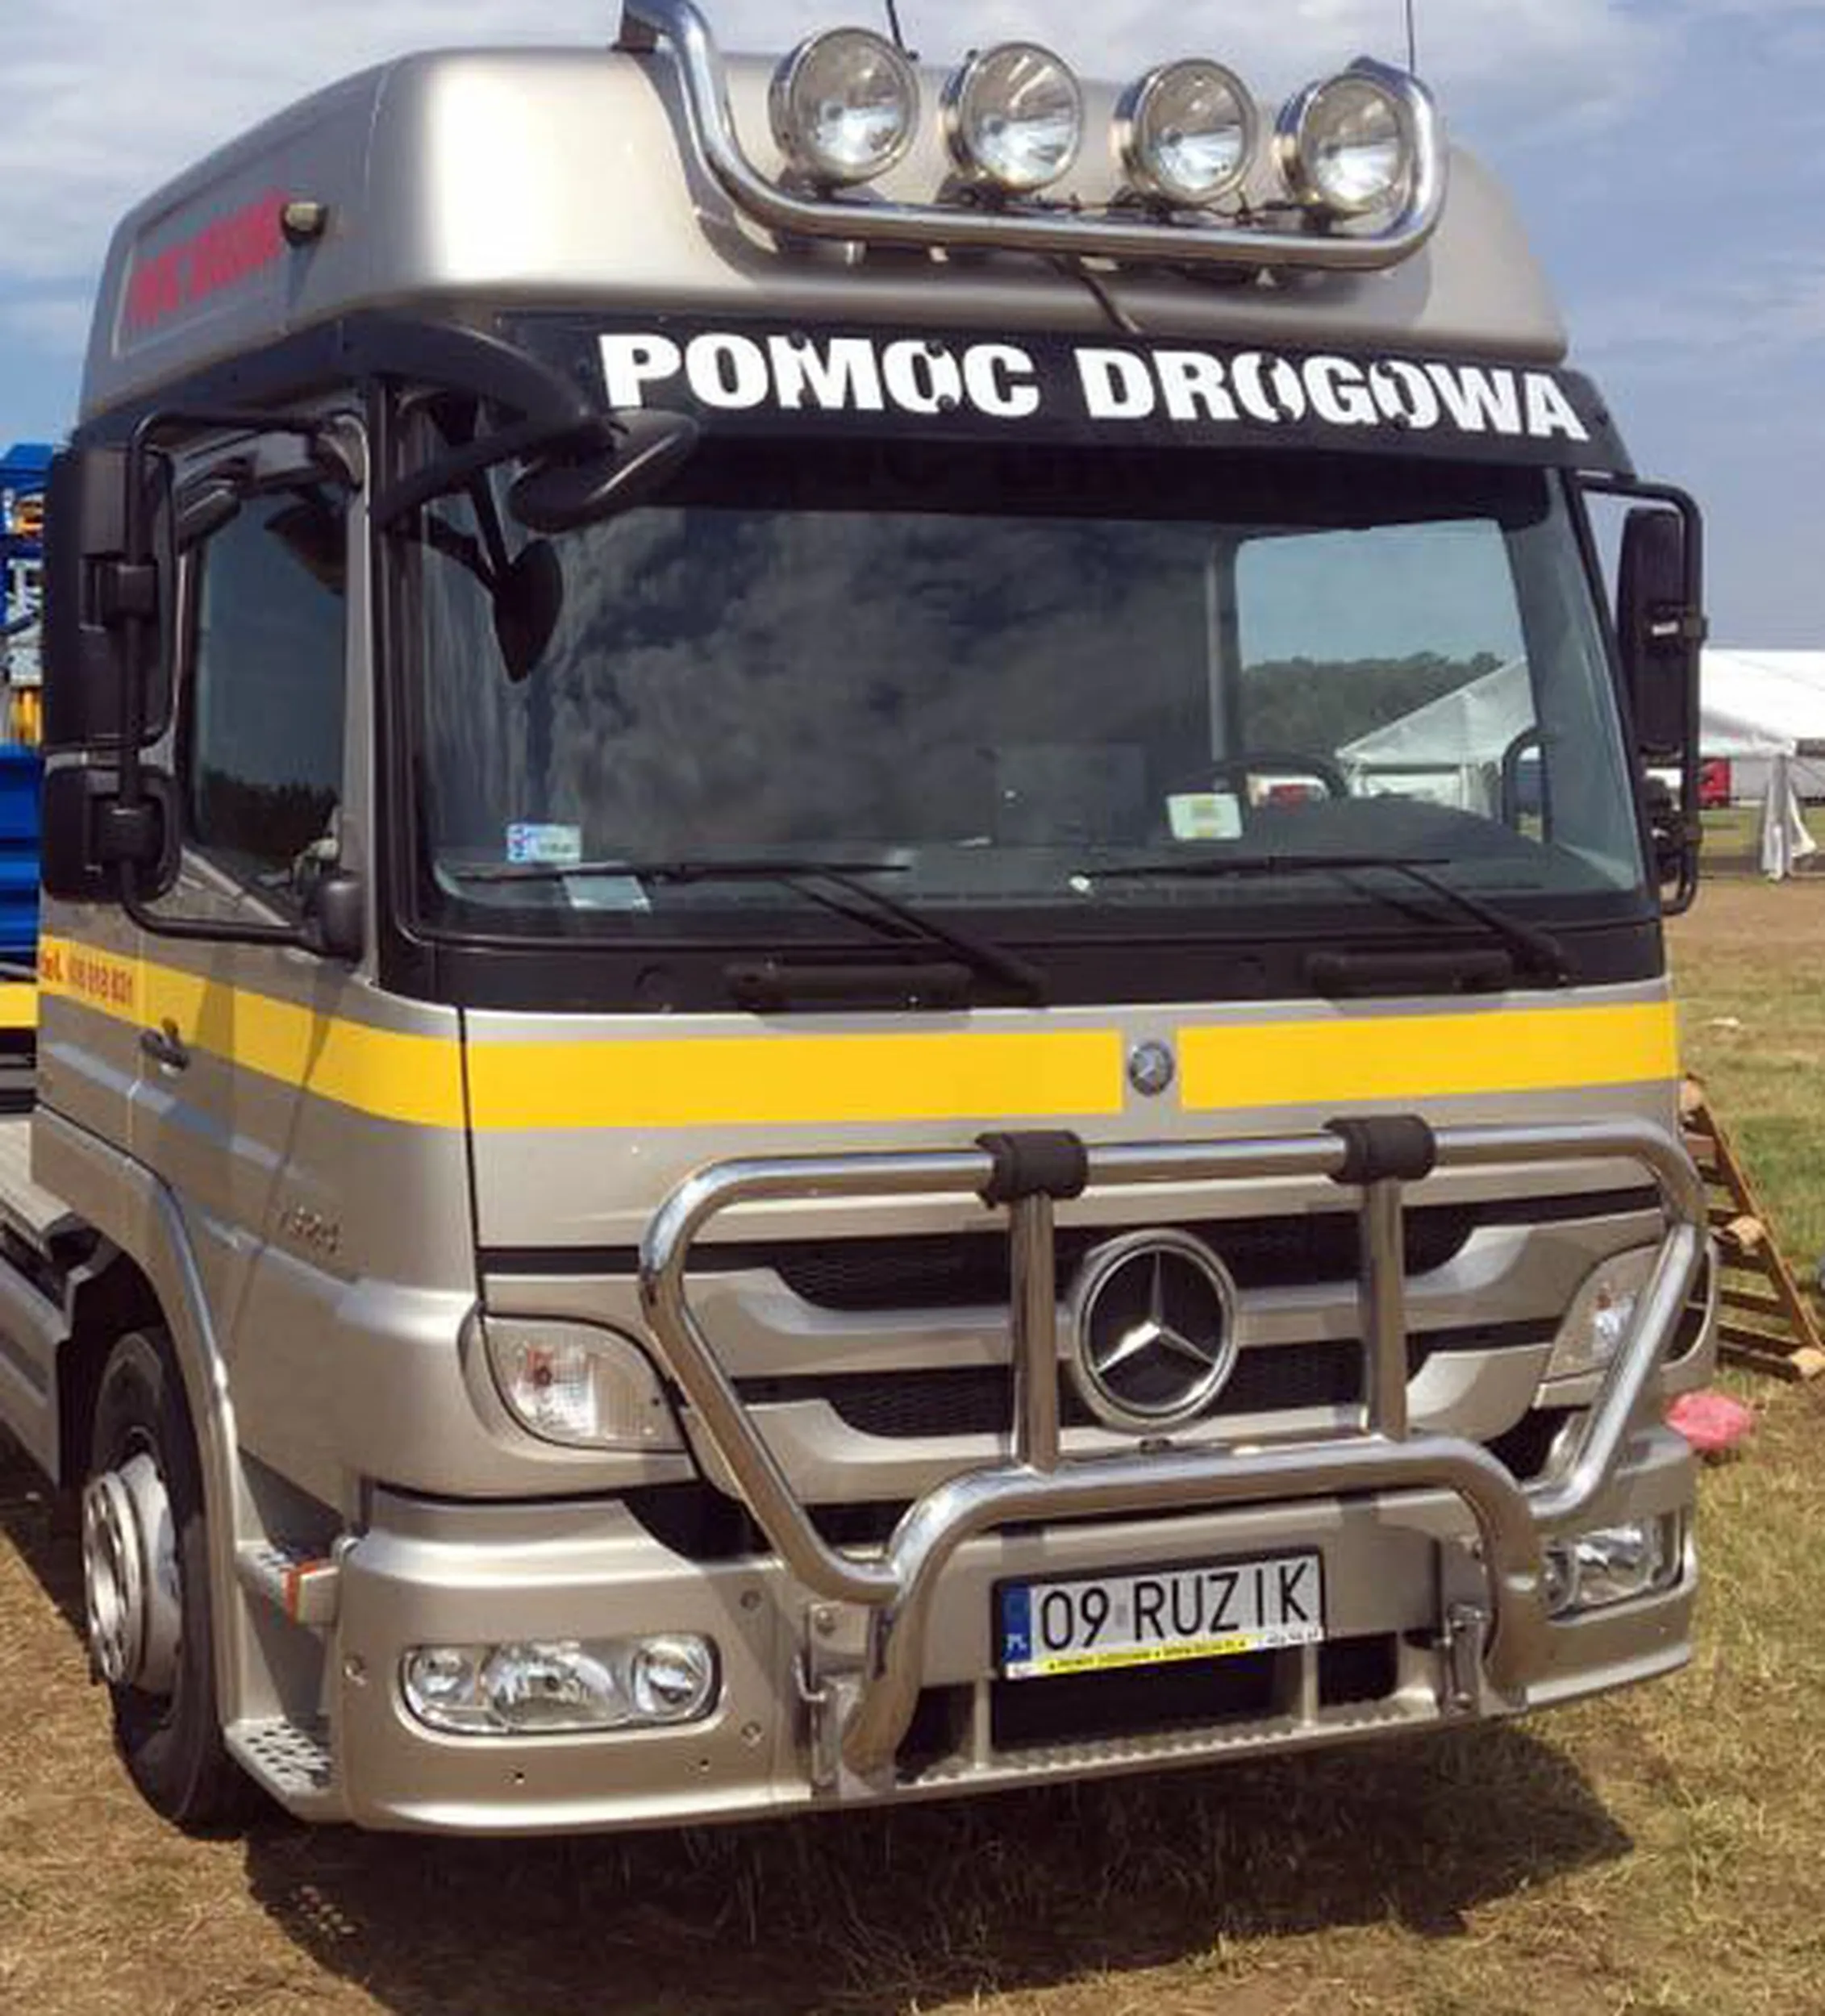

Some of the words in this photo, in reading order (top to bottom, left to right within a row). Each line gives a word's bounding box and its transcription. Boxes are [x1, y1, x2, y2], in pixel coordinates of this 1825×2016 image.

[599, 333, 1040, 417] POMOC
[1074, 348, 1590, 441] DROGOWA
[1133, 1561, 1309, 1642] RUZIK
